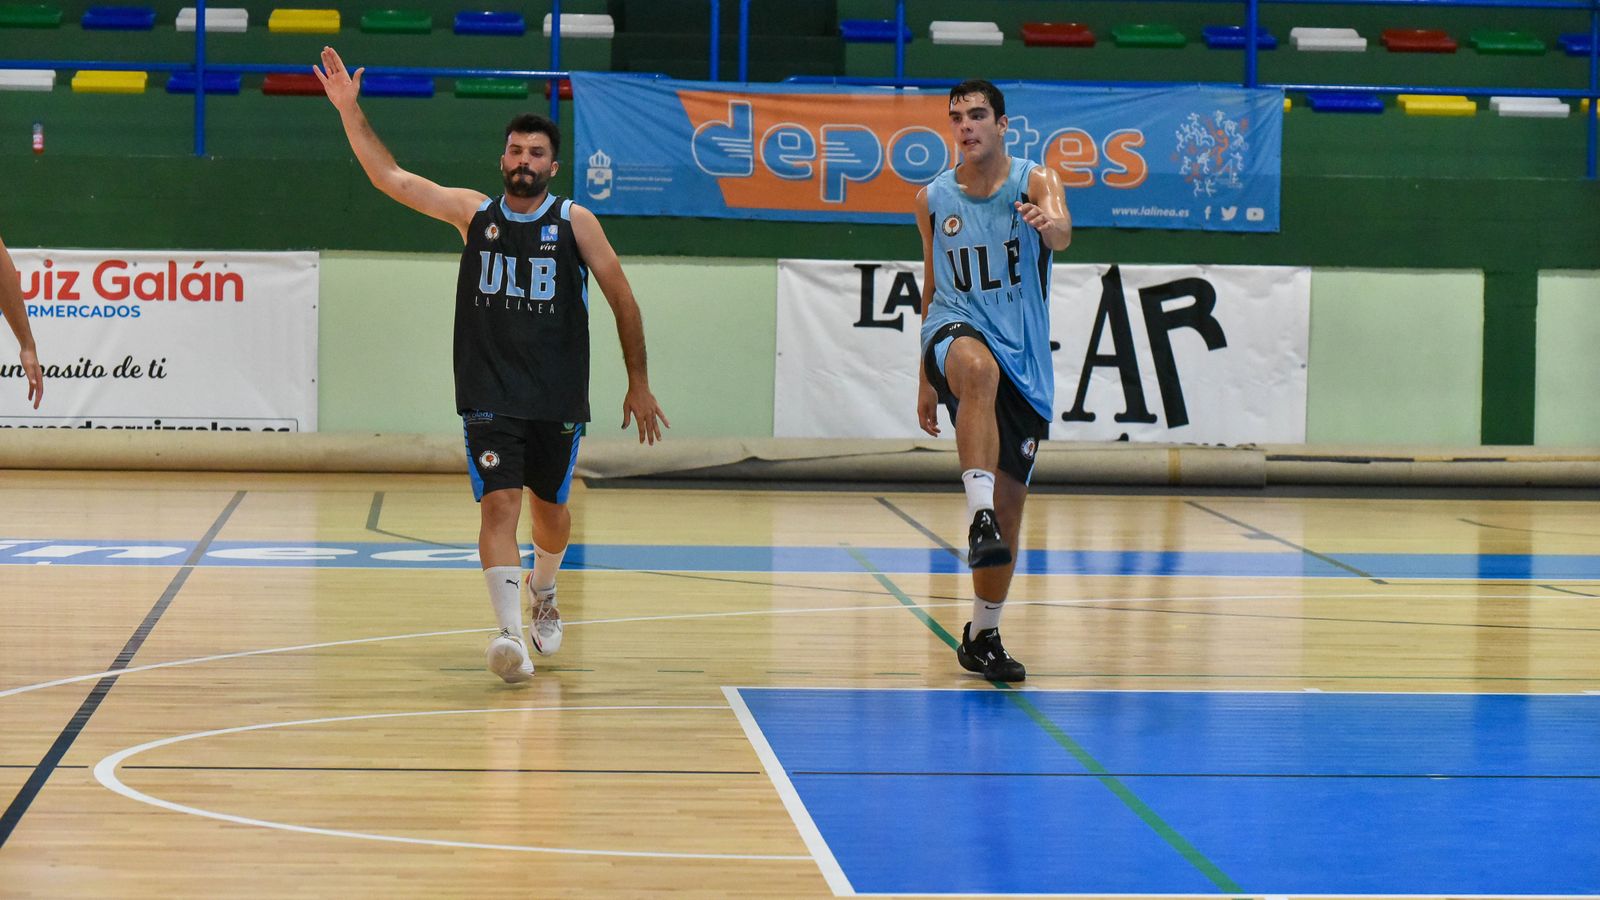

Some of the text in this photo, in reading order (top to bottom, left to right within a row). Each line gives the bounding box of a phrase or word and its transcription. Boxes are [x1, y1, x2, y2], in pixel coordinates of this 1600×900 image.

[691, 99, 1149, 203] depotes
[16, 258, 244, 302] uiz Galán
[478, 250, 558, 301] ULB
[27, 304, 141, 318] RMERCADOS
[475, 295, 491, 308] LA
[853, 263, 923, 333] LA
[40, 357, 107, 379] asito
[112, 355, 143, 378] de
[148, 357, 168, 379] ti
